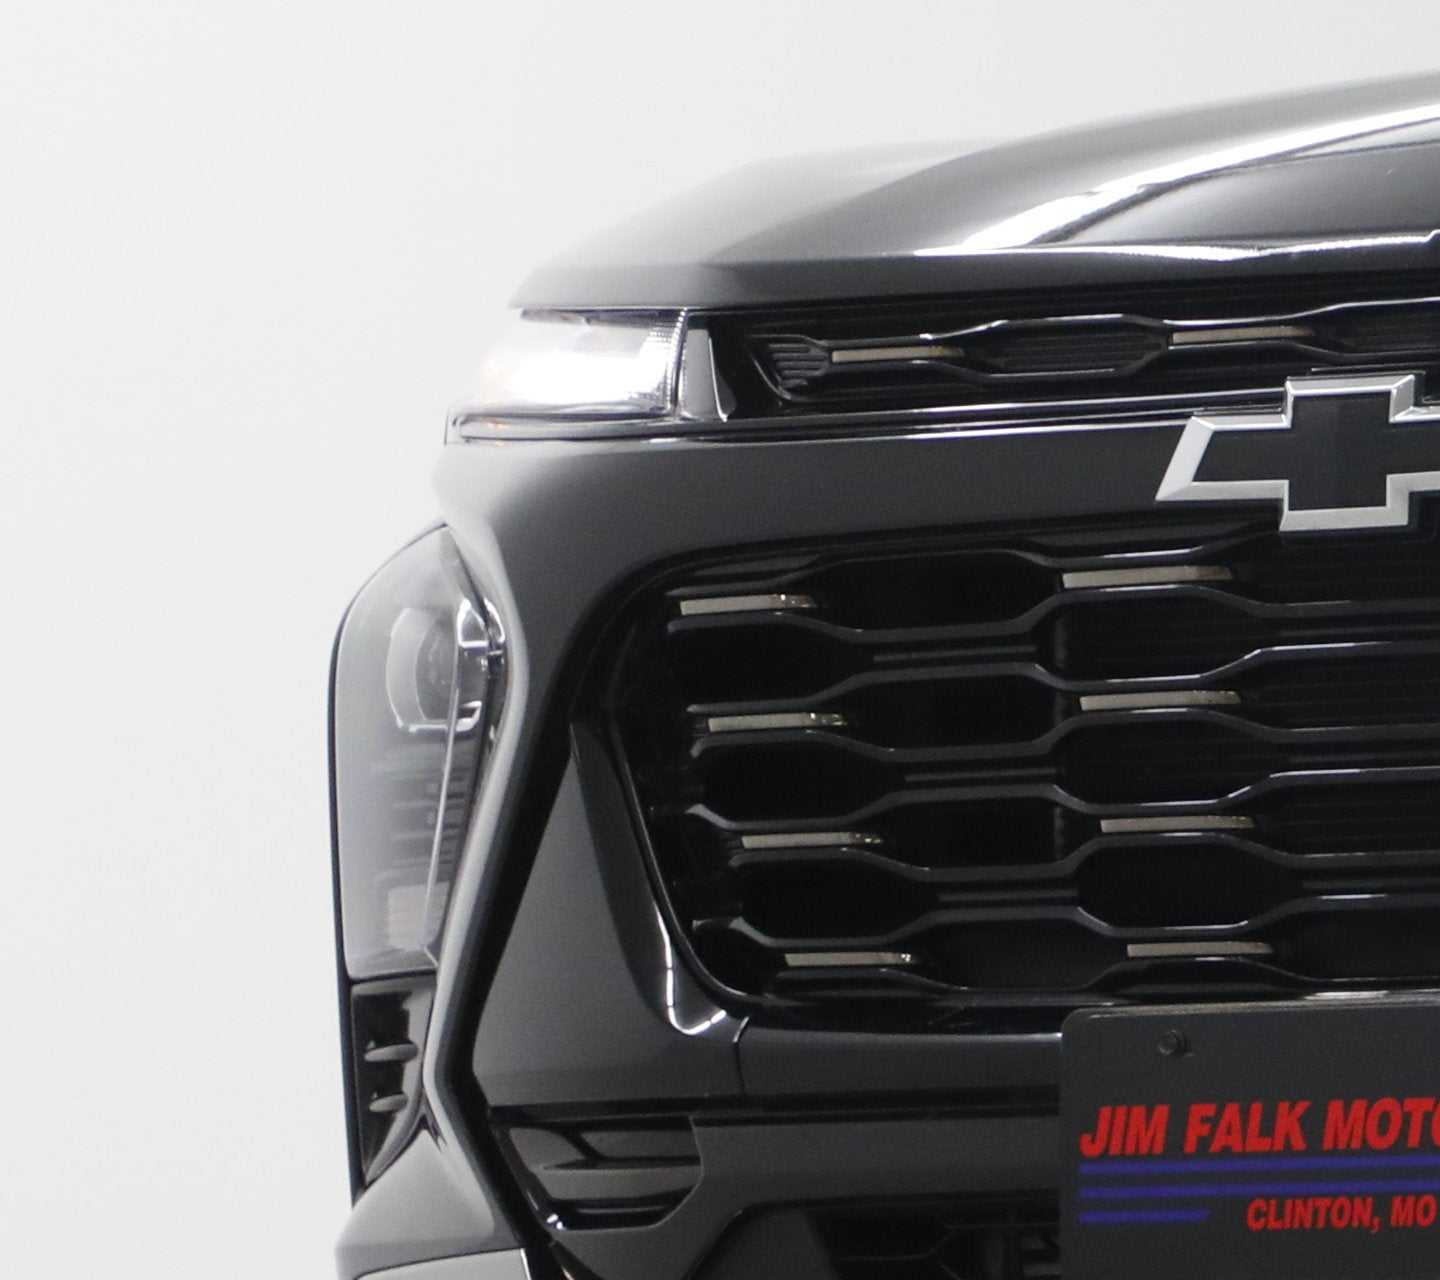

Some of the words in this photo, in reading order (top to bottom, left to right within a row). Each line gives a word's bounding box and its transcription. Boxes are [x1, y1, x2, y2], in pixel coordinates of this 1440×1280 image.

[1080, 1104, 1171, 1157] JIM
[1183, 1101, 1311, 1154] FALK
[1246, 1196, 1381, 1233] CLINTON,
[1390, 1194, 1439, 1228] MO
